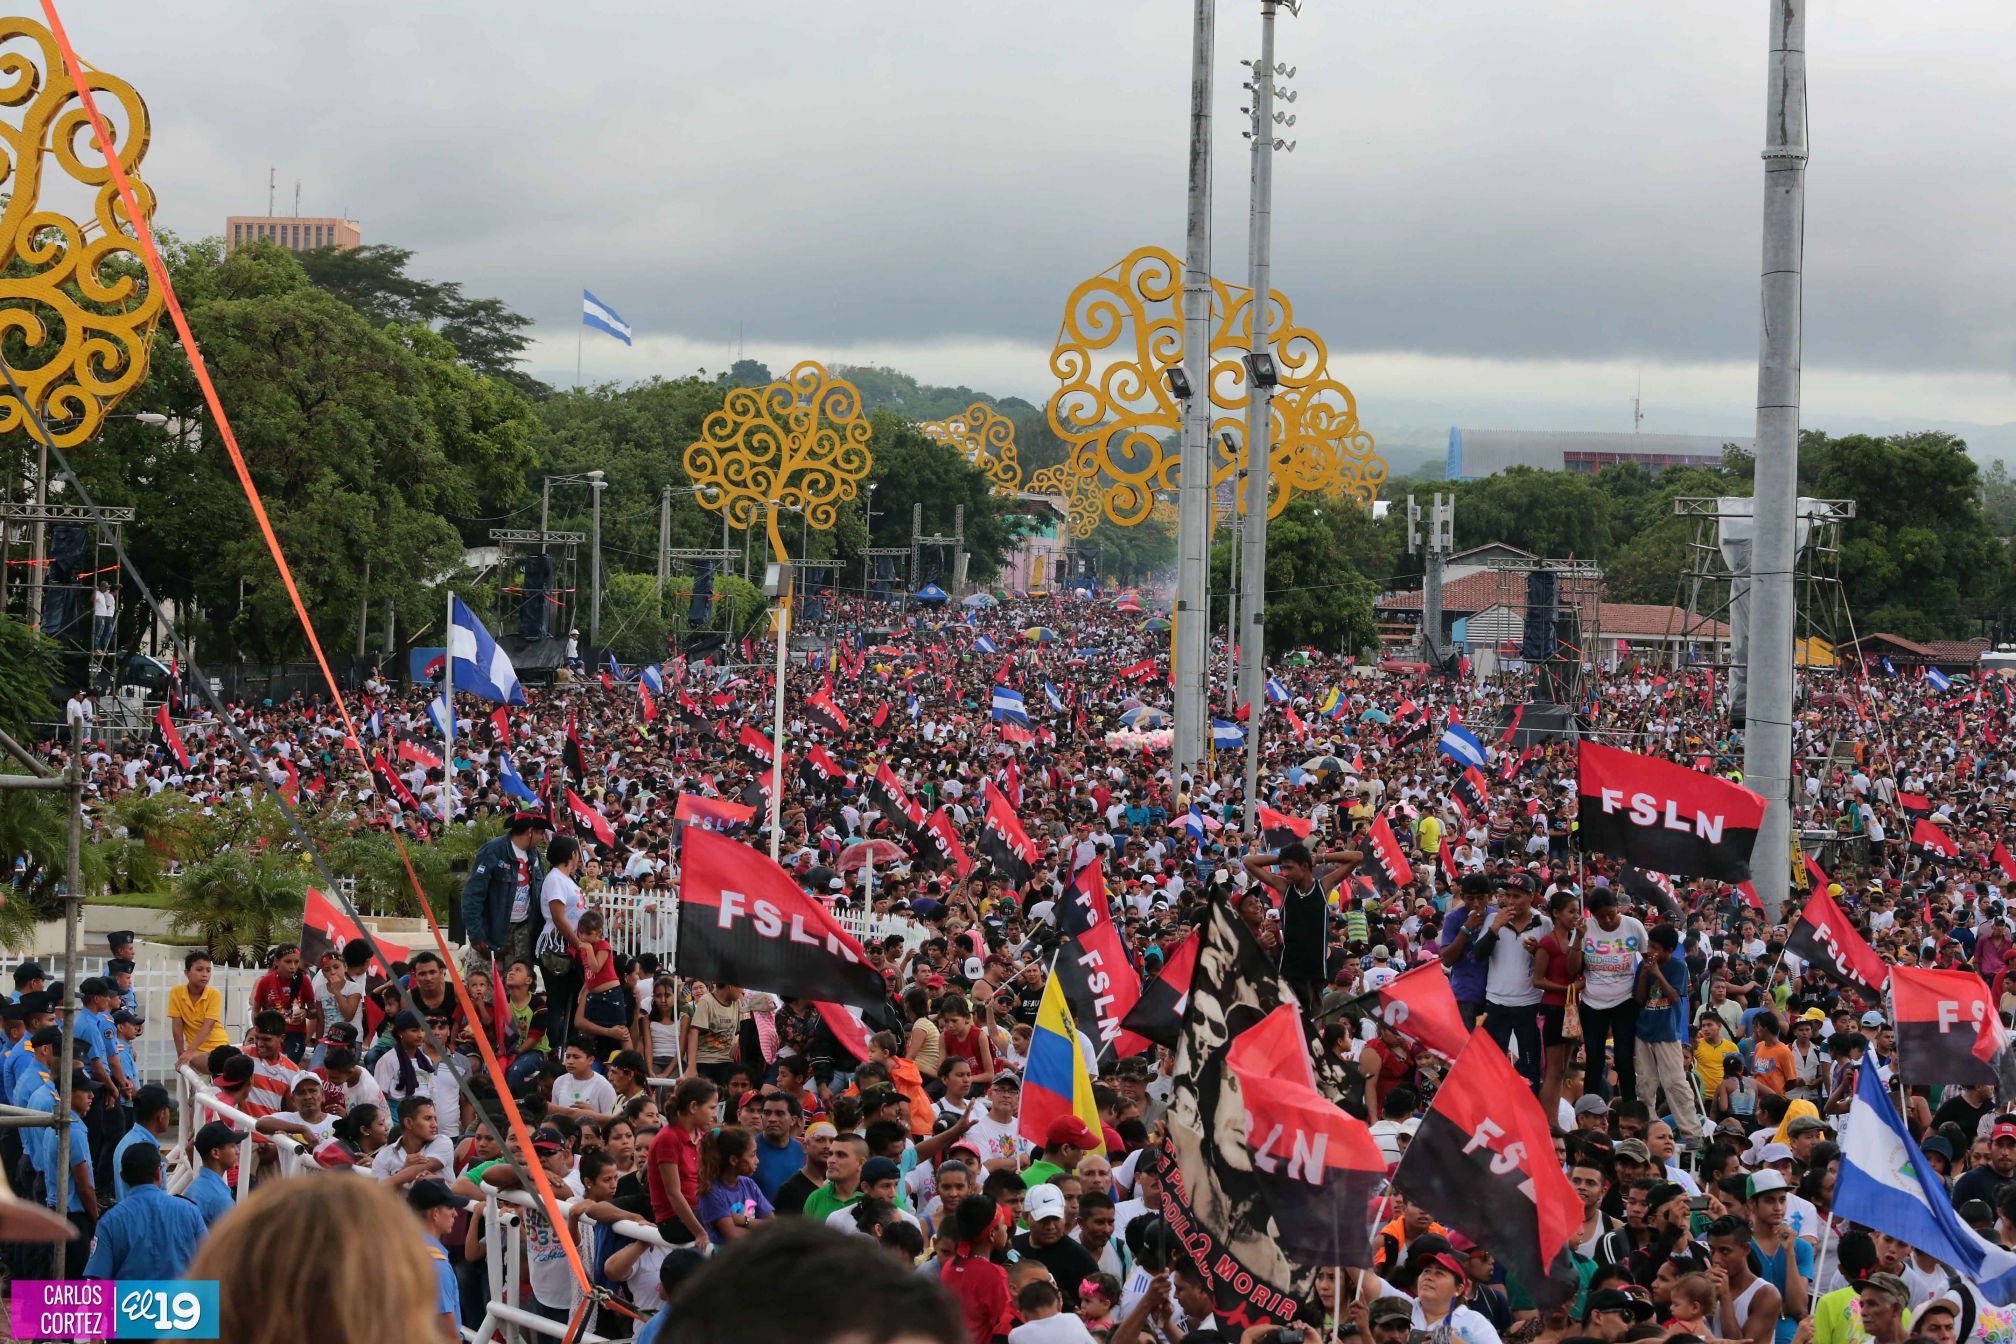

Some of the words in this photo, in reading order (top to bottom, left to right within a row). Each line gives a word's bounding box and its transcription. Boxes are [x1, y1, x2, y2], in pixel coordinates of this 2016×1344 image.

[986, 816, 1028, 861] FSLN
[1601, 786, 1724, 844] FSLN
[1369, 834, 1397, 881] FSLN
[717, 889, 860, 964] FSLN
[1812, 922, 1867, 987] FSLN
[1078, 949, 1123, 1042] FSLN
[1214, 1254, 1297, 1321] MORIR
